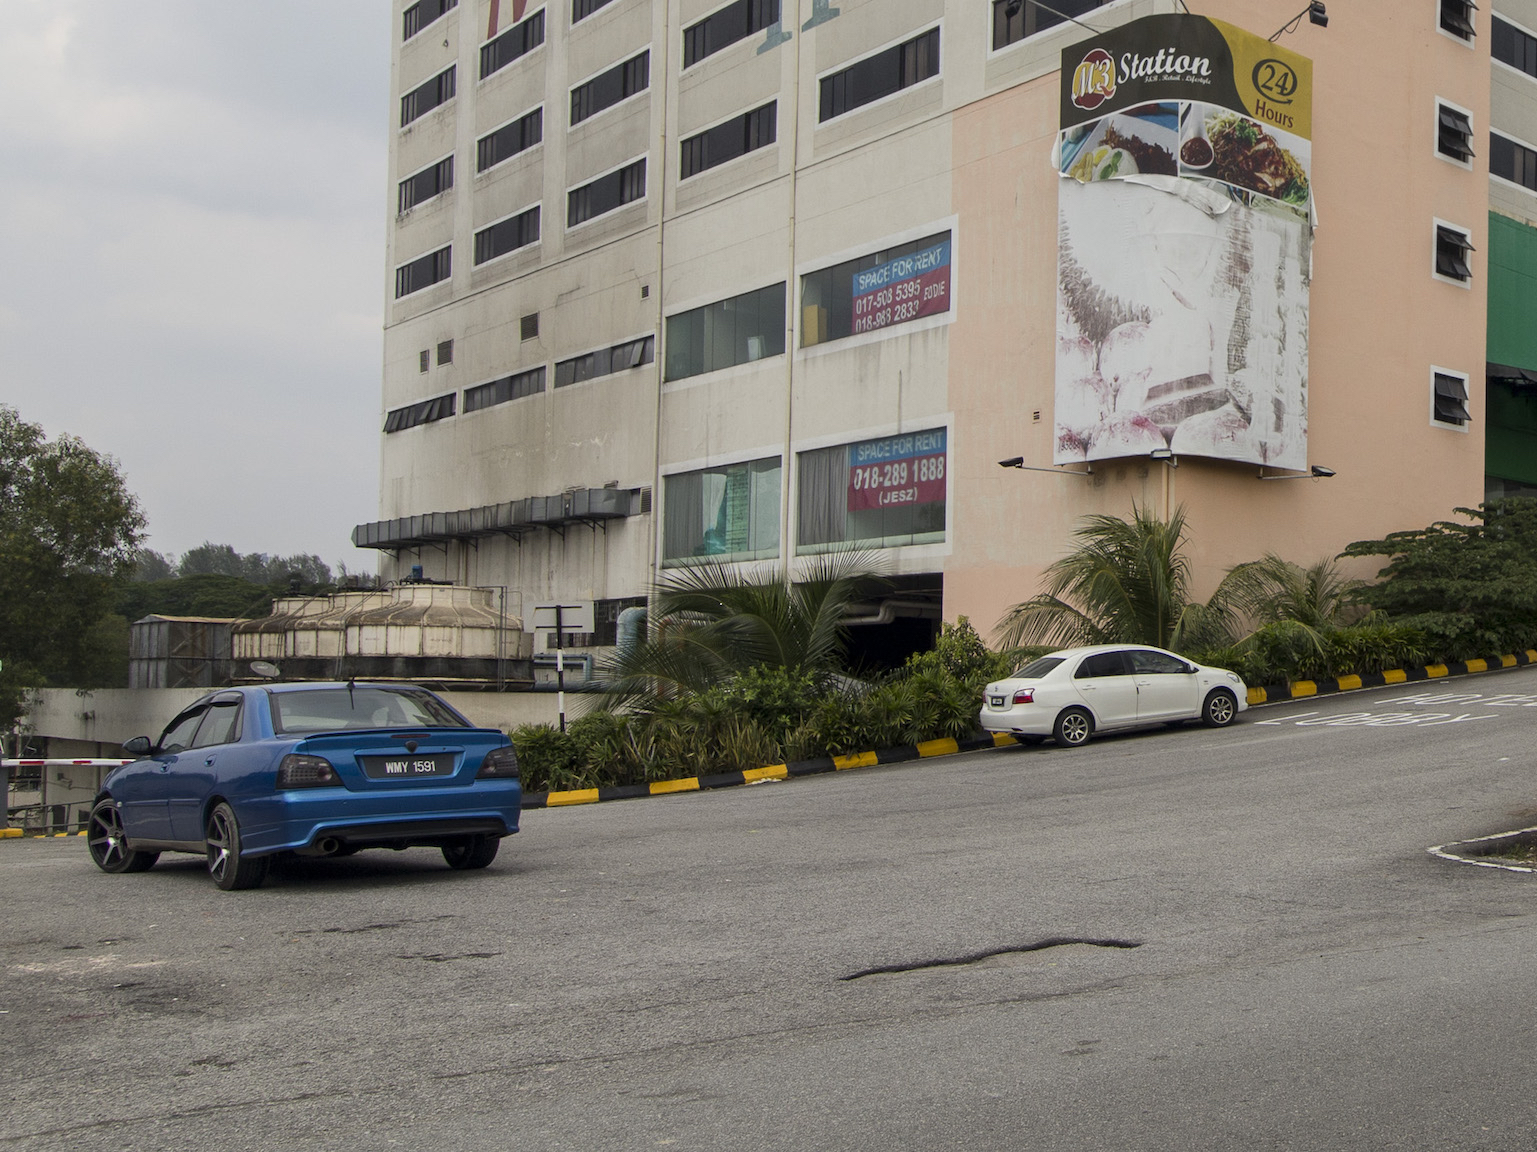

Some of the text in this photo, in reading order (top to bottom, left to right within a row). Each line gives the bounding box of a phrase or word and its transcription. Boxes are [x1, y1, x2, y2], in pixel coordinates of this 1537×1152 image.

[1117, 47, 1212, 84] Station
[1261, 64, 1290, 96] 24
[1255, 98, 1294, 128] Hours
[859, 248, 942, 290] SPACE FOR RENT
[856, 288, 893, 314] 017-508
[858, 432, 943, 461] SPACE FOR RENT
[854, 456, 945, 490] 018-289 1888
[879, 487, 918, 505] (JESZ)
[385, 760, 436, 774] WMY 1591
